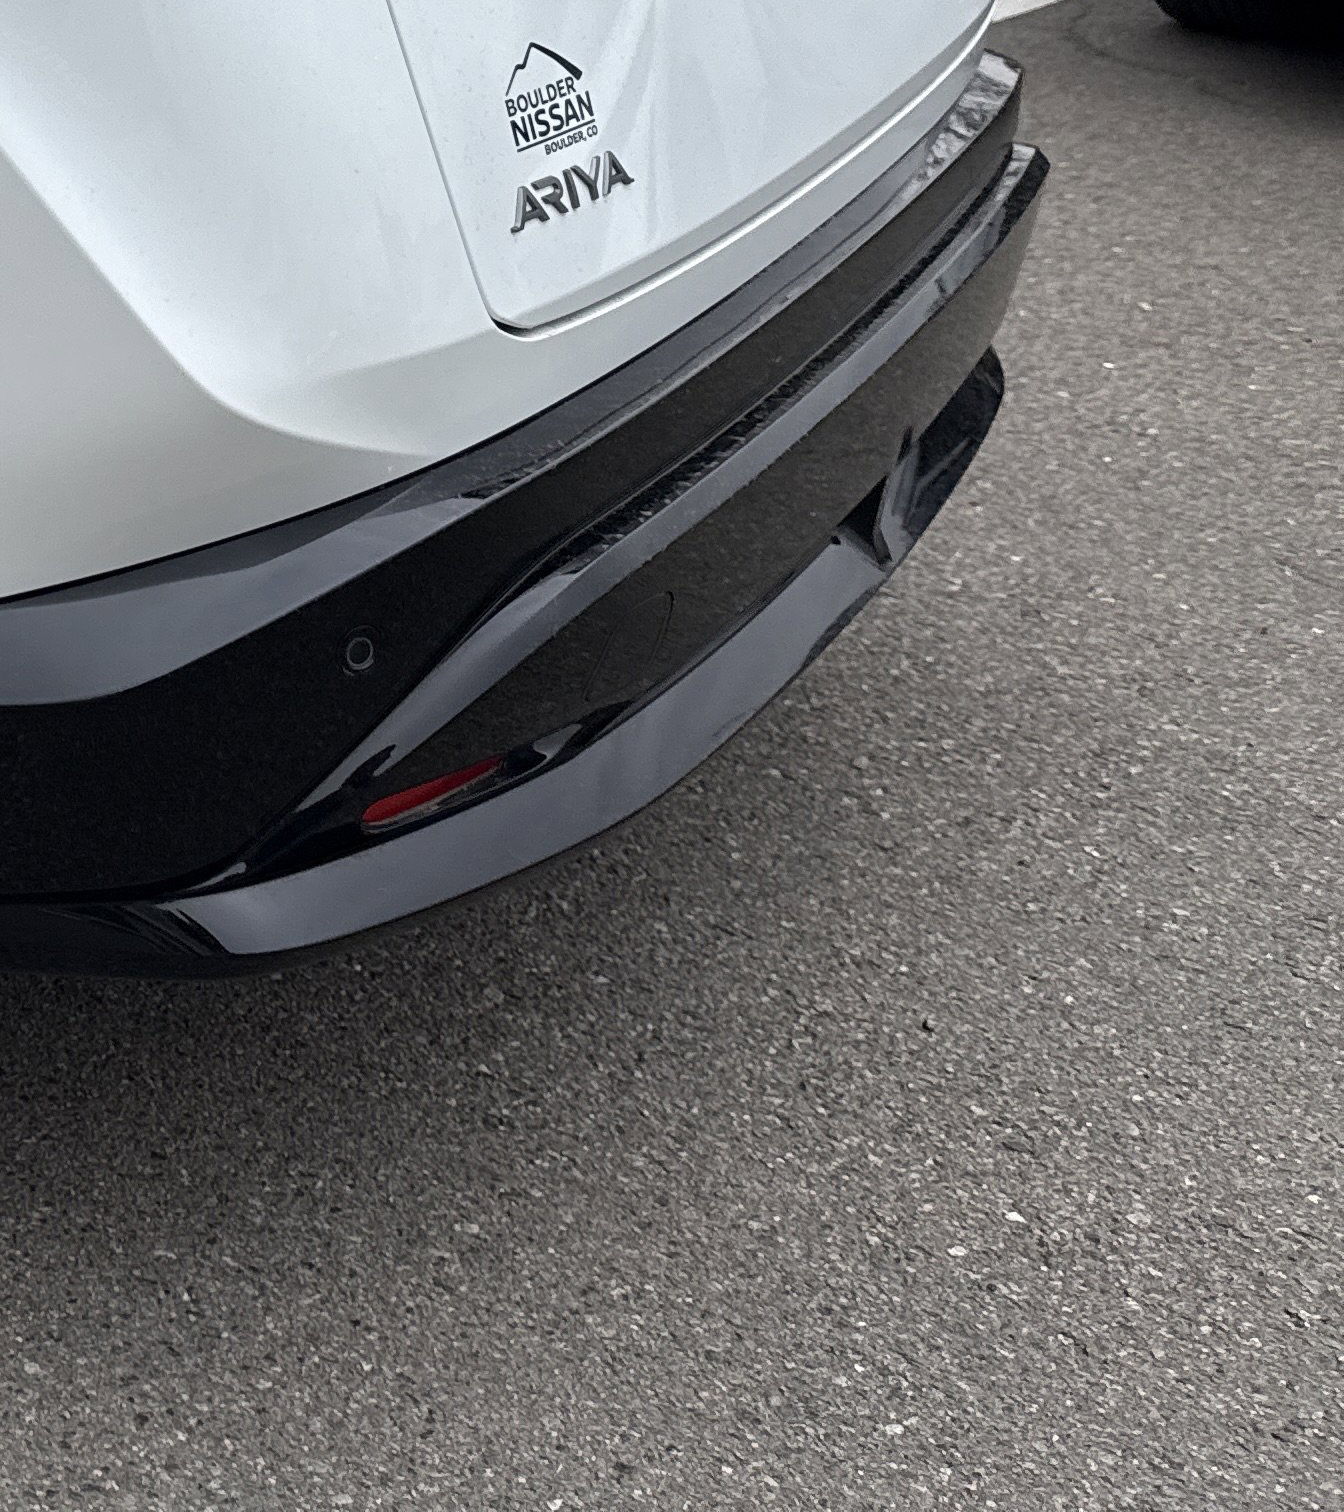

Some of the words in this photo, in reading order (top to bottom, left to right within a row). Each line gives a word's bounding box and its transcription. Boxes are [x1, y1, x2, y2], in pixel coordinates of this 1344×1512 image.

[505, 76, 577, 118] BOULDER
[510, 91, 595, 147] NISSAN
[544, 131, 587, 156] BOULDER,
[586, 124, 599, 138] CO
[510, 150, 635, 233] ARIYA
